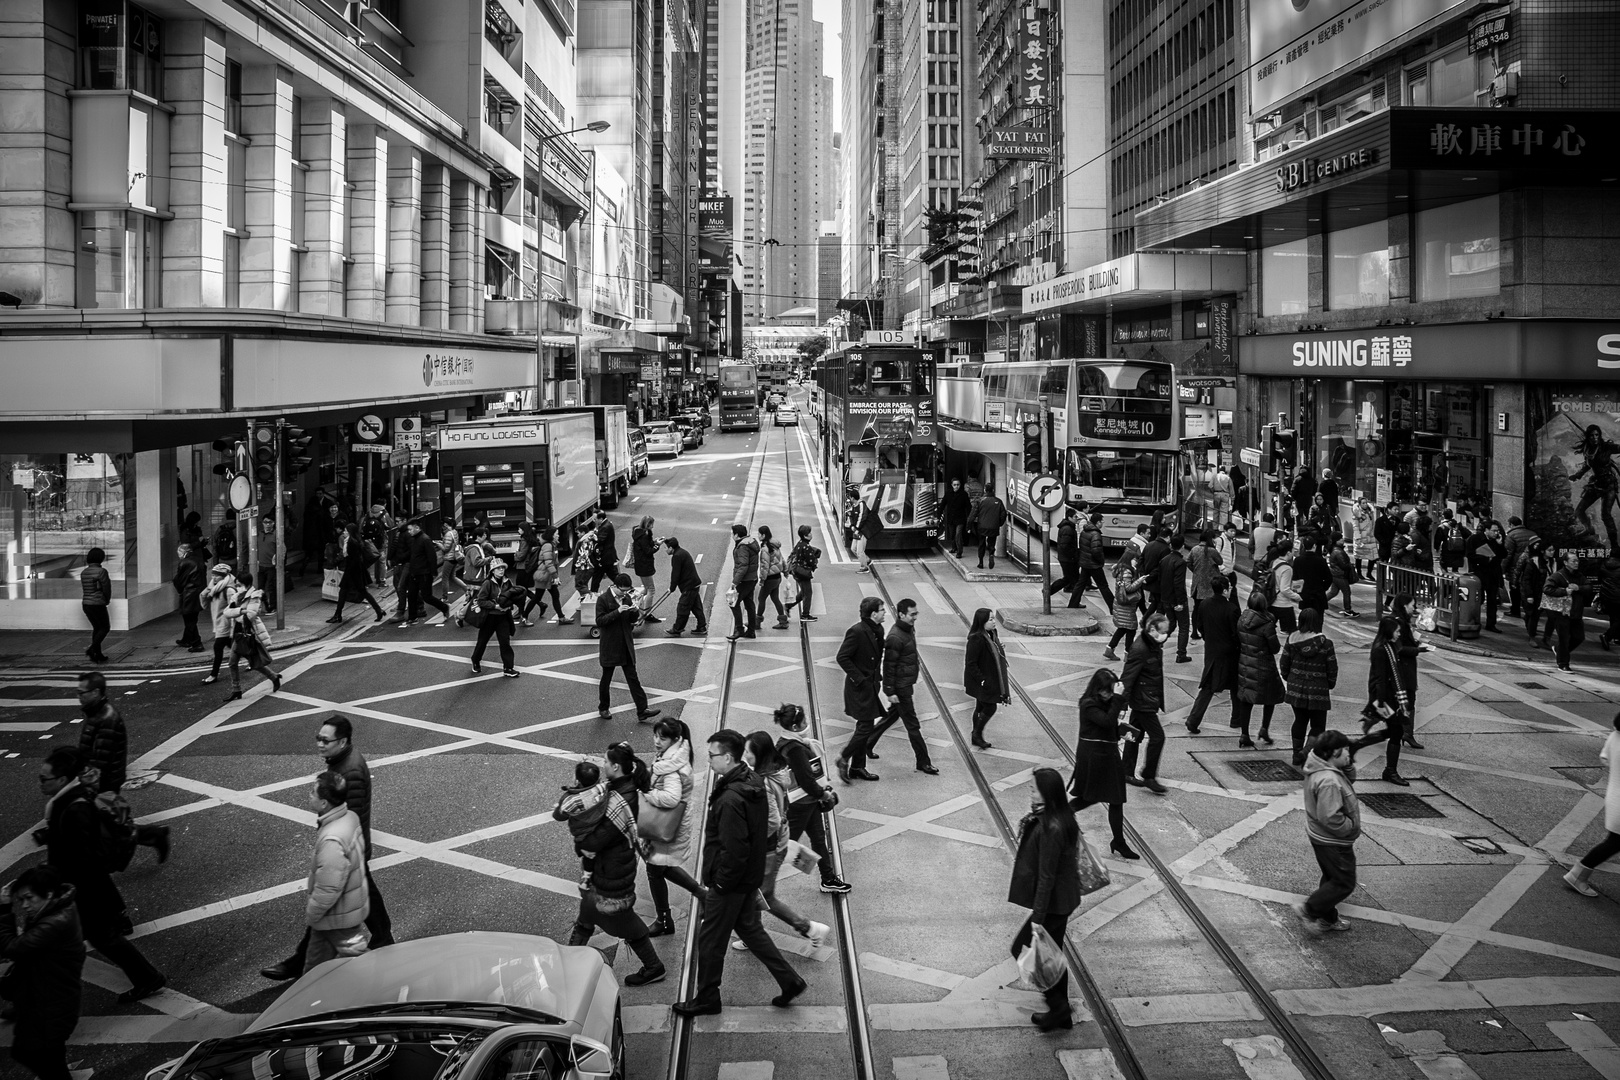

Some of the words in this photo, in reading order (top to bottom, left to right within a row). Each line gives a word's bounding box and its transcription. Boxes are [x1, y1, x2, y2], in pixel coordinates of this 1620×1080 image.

[86, 14, 113, 25] PRIVATE
[1023, 20, 1046, 105] 日發文具
[689, 69, 697, 172] SIBERIAN
[995, 131, 1018, 142] YAT
[1025, 131, 1046, 142] FAT
[1430, 123, 1586, 156] 軟庫中心
[993, 146, 1050, 154] STATIONERS
[1276, 158, 1309, 192] SBI
[1317, 148, 1365, 178] CENTRE
[689, 186, 697, 223] FUR
[708, 202, 724, 210] KEF
[689, 236, 697, 301] STORE
[1052, 277, 1085, 299] PROSPEROUS
[1089, 267, 1119, 291] BUILDING
[879, 331, 904, 342] 105
[1292, 339, 1367, 367] SUNING
[1371, 335, 1412, 367] 蘇寧
[1552, 401, 1592, 412] TOMB
[1097, 418, 1139, 429] 堅尼地城
[1141, 421, 1154, 435] 10
[448, 434, 460, 442] HO
[463, 432, 489, 441] FUNG
[492, 430, 537, 440] LOGISTICS
[1094, 427, 1121, 435] Kennedy
[926, 529, 937, 537] 105
